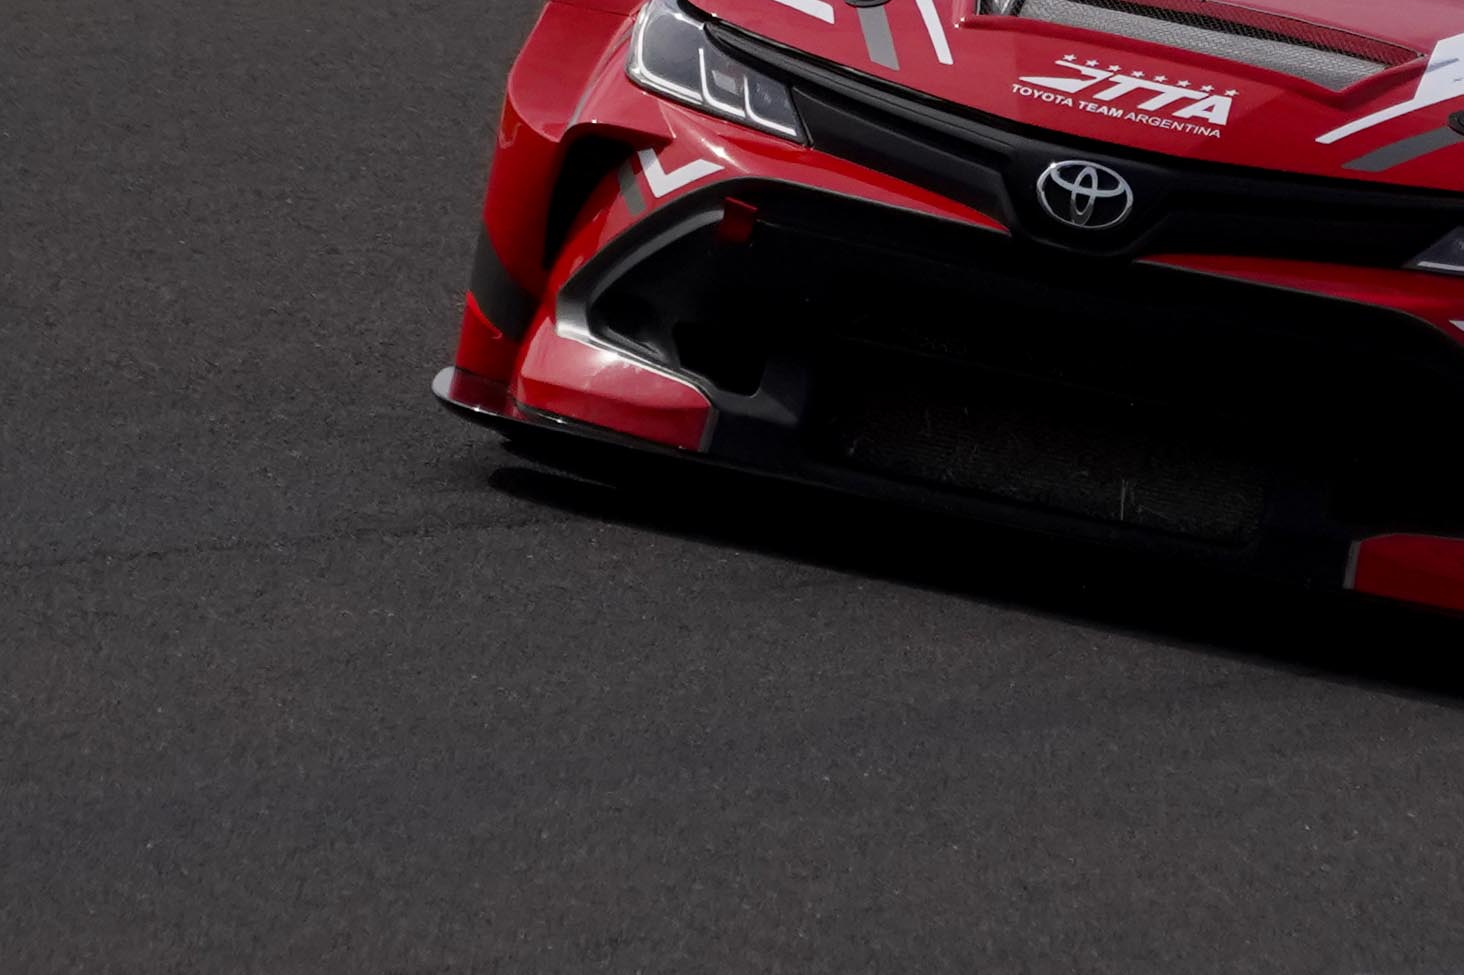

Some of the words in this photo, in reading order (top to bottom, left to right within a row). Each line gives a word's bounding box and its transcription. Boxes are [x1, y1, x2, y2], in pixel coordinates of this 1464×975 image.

[1011, 84, 1073, 107] TOYOTA
[1078, 101, 1123, 118] TEAM
[1124, 112, 1221, 138] ARGENTINA
